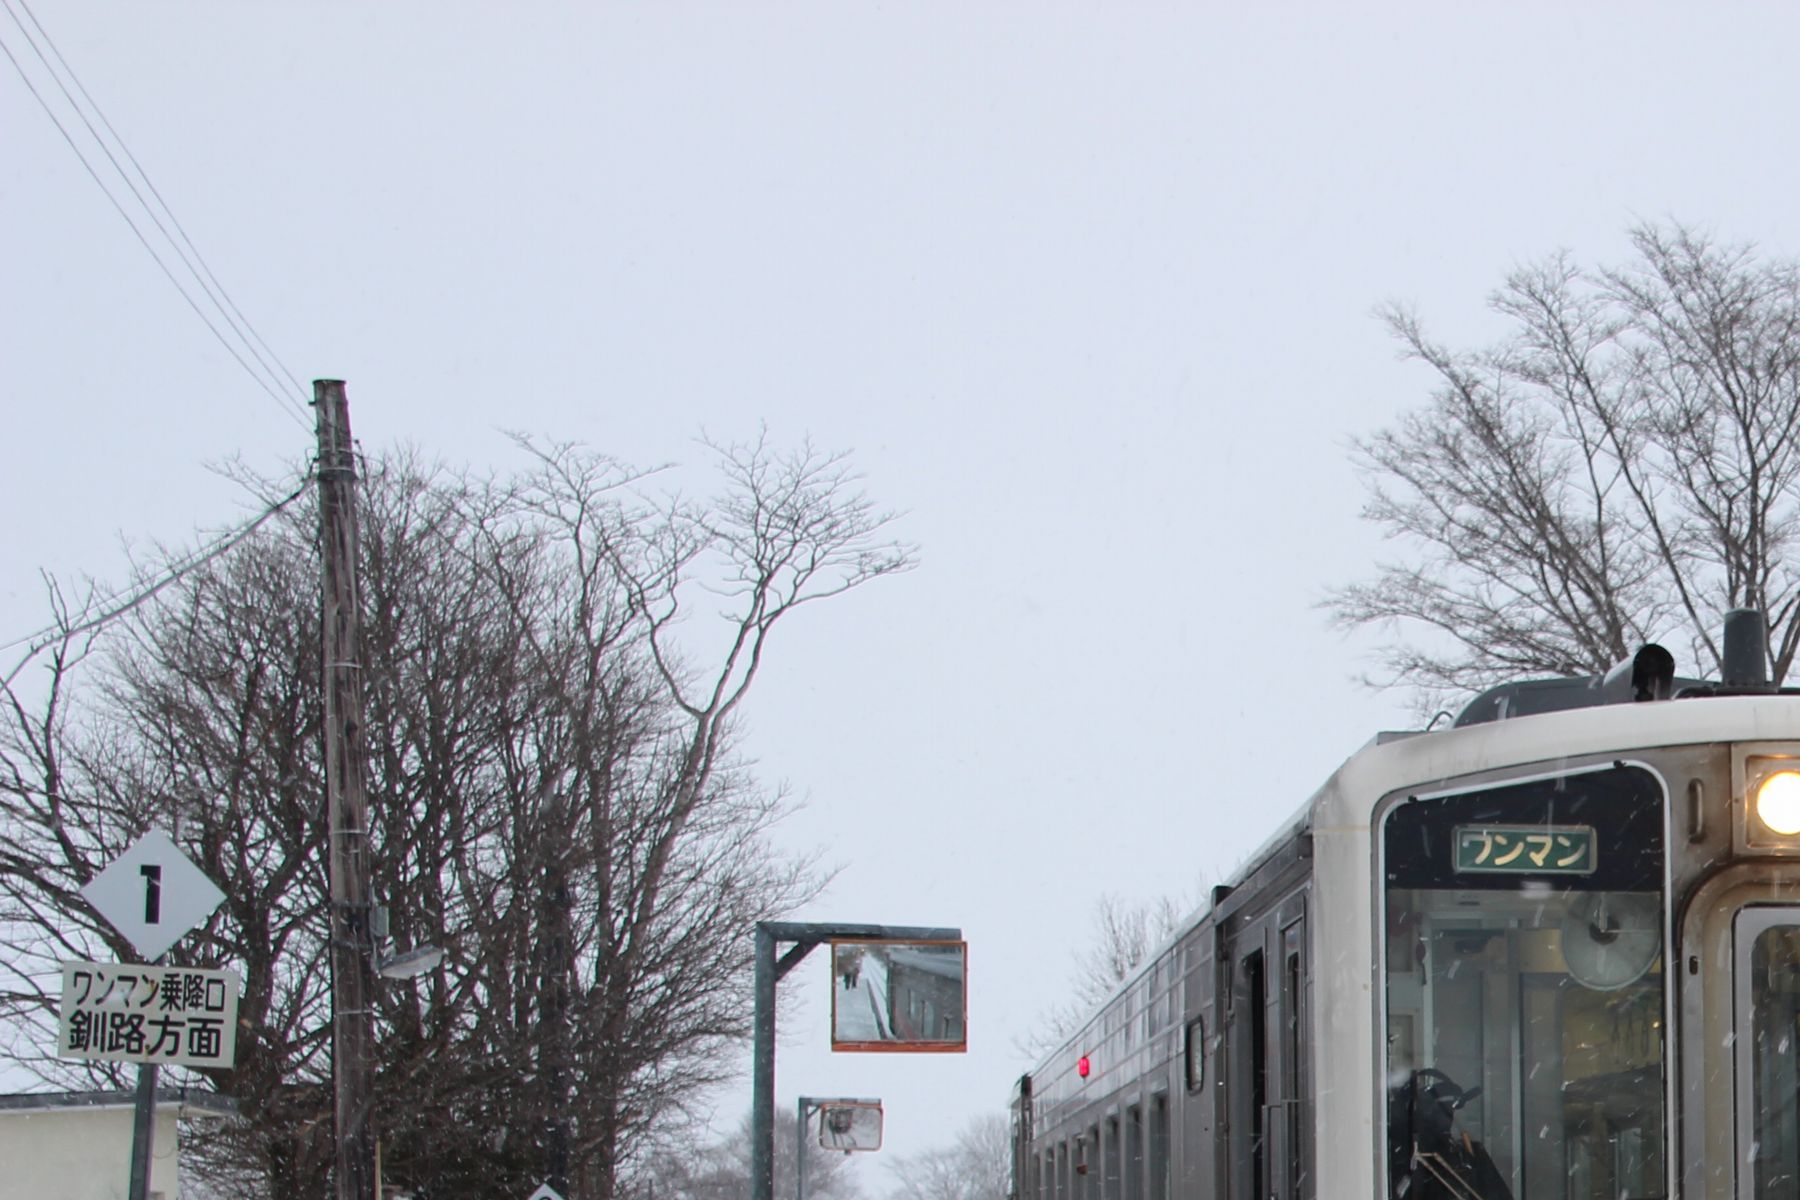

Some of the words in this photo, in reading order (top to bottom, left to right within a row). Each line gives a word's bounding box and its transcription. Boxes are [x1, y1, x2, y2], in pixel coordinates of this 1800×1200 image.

[1460, 834, 1587, 867] ワンマン
[140, 864, 162, 924] 1
[73, 971, 226, 1012] ワンマン乗降口
[68, 1009, 225, 1058] 釧路方面
